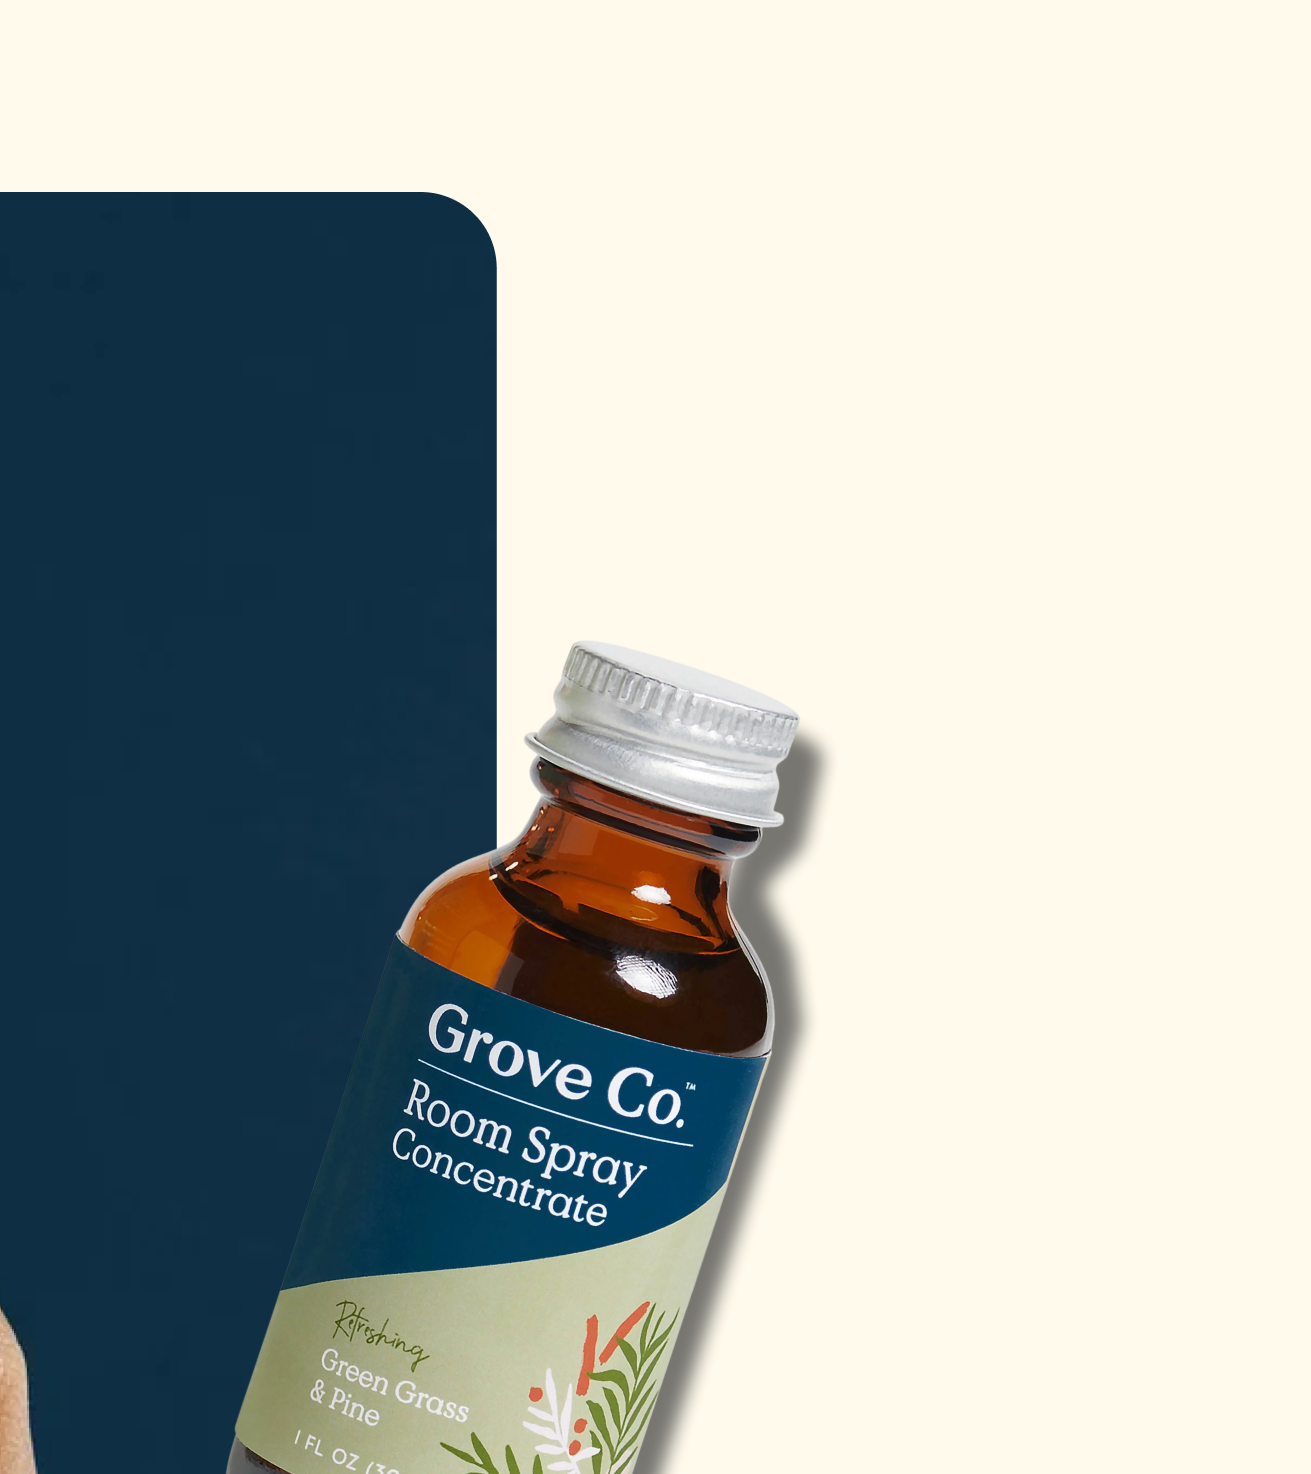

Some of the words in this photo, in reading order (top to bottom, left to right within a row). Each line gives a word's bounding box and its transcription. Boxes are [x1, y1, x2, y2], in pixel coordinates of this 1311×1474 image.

[428, 1003, 592, 1100] Grove
[403, 1078, 513, 1154] Room
[521, 1126, 648, 1199] Spray
[392, 1127, 608, 1227] Concentrate
[332, 1300, 430, 1372] Refreshing
[310, 1379, 325, 1403] &
[328, 1386, 380, 1427] Pine
[321, 1348, 389, 1396] Green
[394, 1380, 470, 1423] Grass
[304, 1435, 323, 1457] FL
[331, 1448, 360, 1470] OZ
